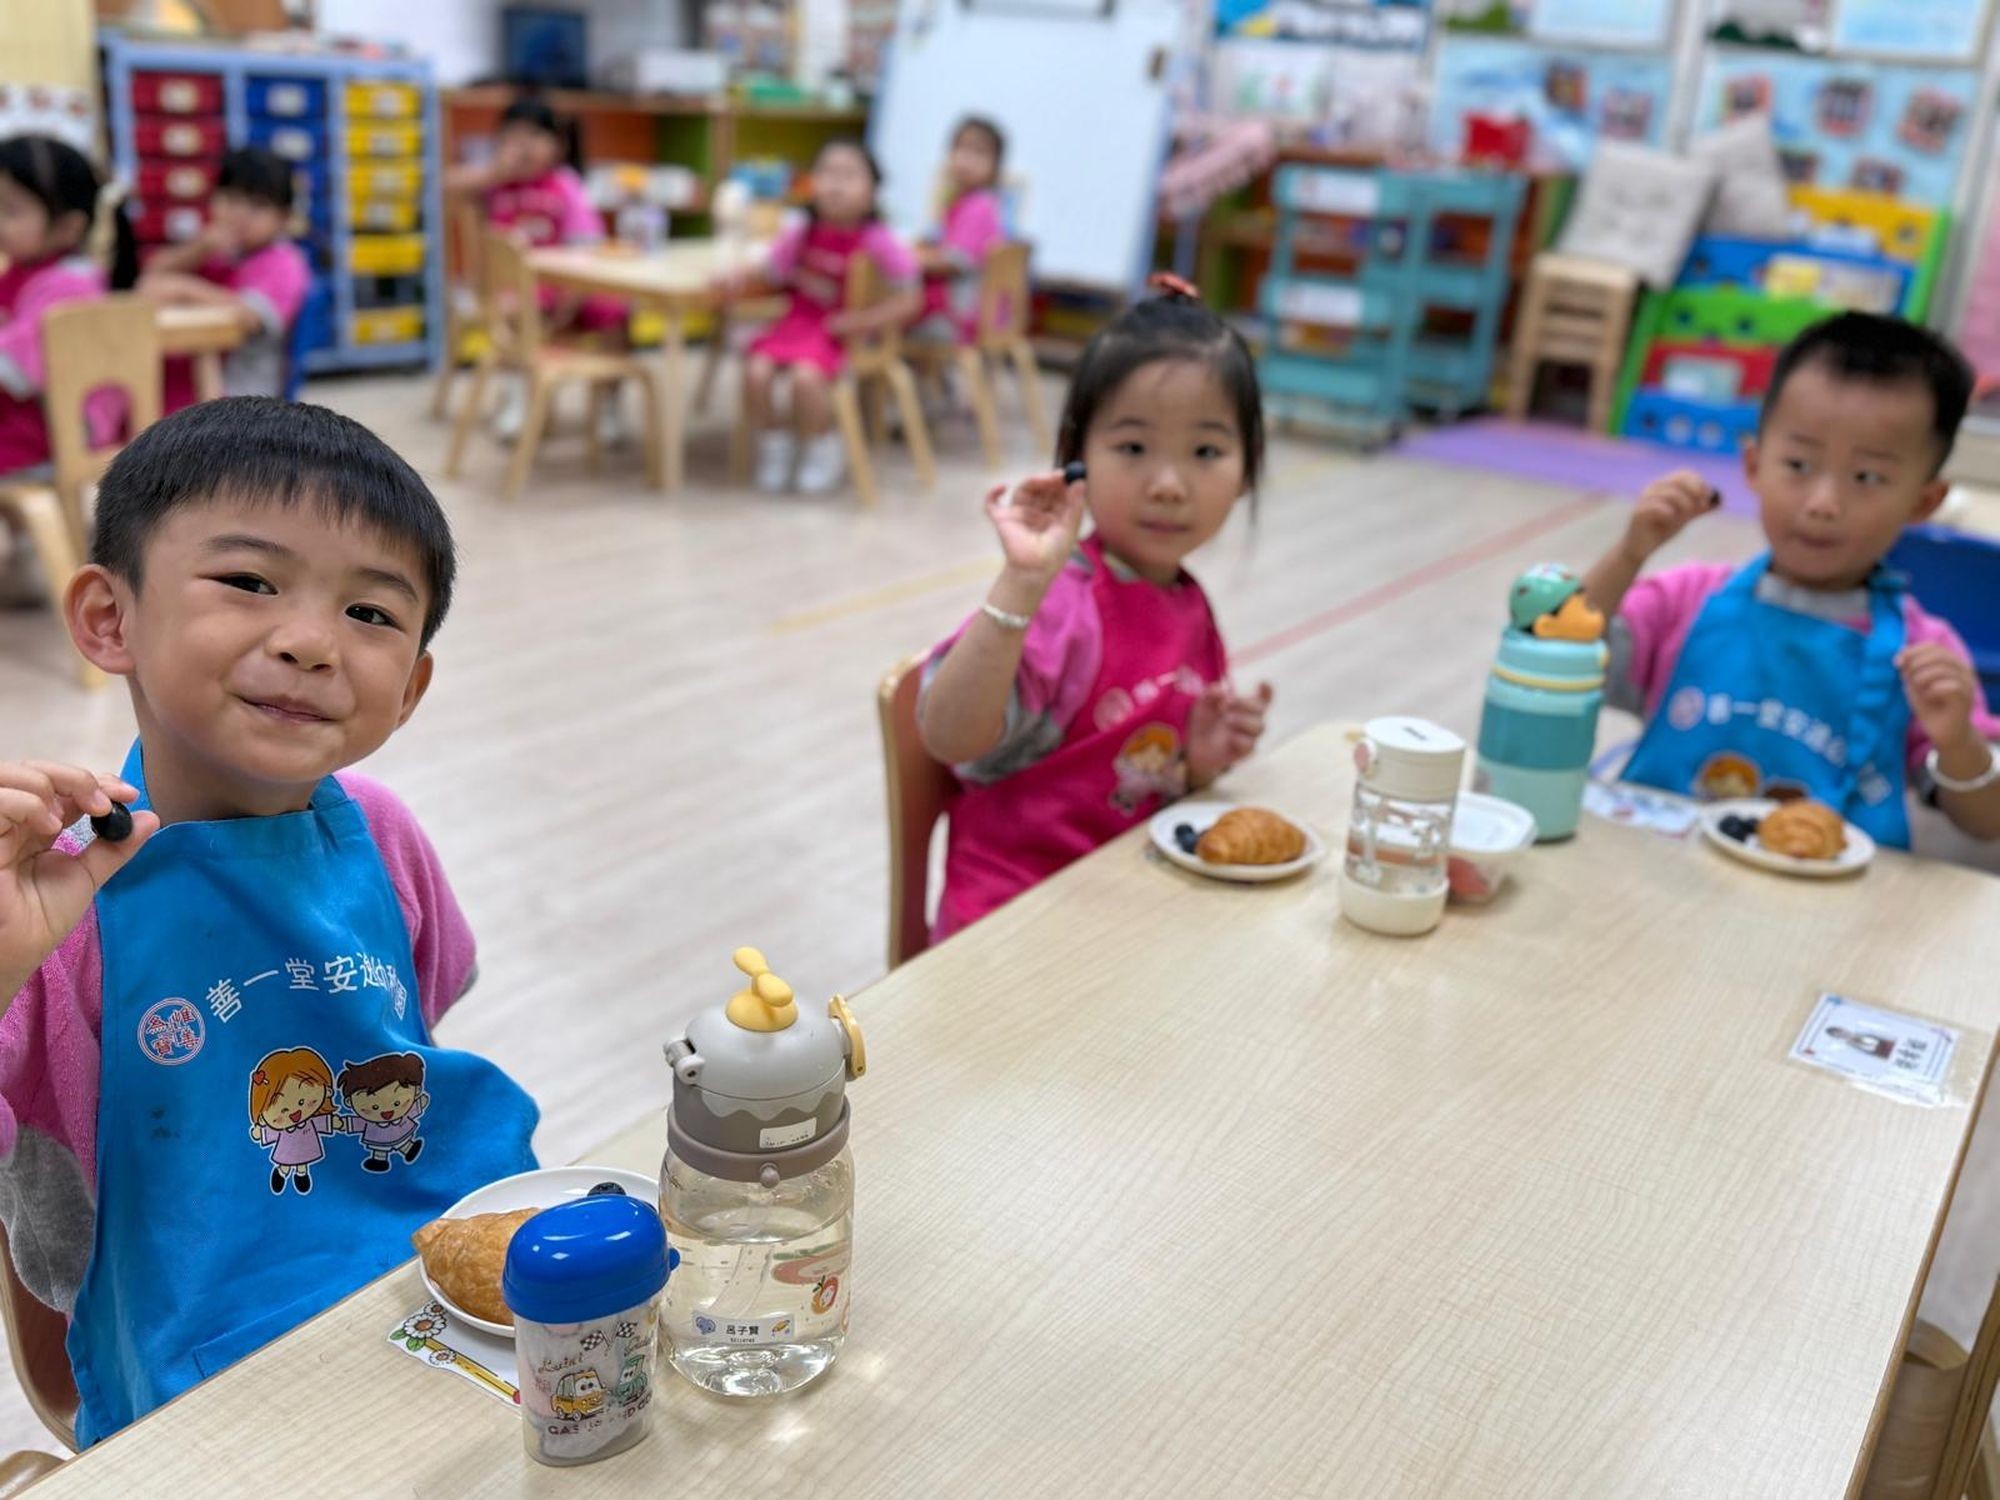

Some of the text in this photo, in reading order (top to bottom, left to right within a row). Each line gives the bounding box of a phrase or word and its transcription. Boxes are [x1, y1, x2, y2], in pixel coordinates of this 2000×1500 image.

[205, 952, 408, 1023] 善一堂安逸
